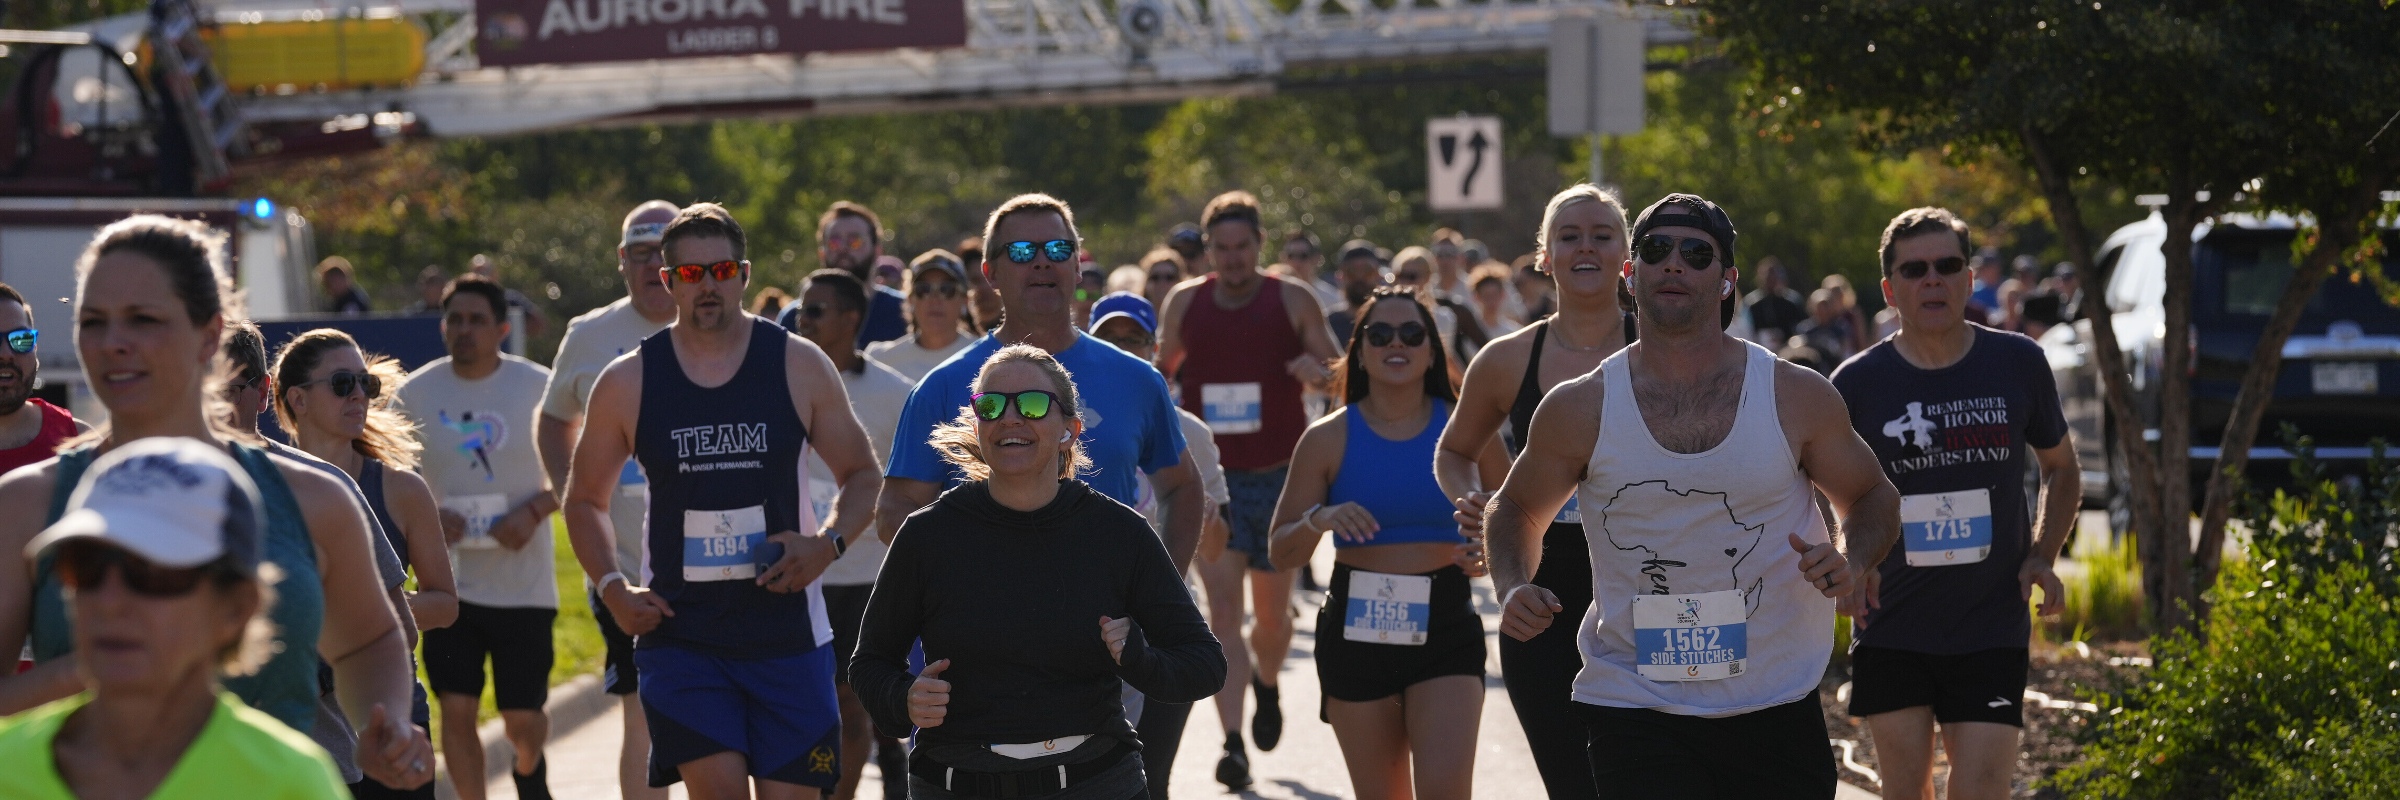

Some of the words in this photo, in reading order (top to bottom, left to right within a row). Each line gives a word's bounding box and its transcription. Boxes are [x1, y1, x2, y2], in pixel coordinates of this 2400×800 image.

[537, 0, 769, 40] AURORA
[788, 0, 908, 25] FIRE
[1927, 397, 2007, 416] REMEMBER
[1944, 409, 2009, 428] HONOR
[671, 423, 768, 458] TEAM
[692, 463, 715, 472] KAISER
[1891, 447, 2010, 474] UNDERSTAND
[1564, 510, 1580, 522] SID
[1925, 518, 1972, 541] 1715
[703, 535, 750, 557] 1694
[1641, 560, 1687, 595] ken
[1364, 600, 1409, 621] 1556
[1662, 626, 1721, 652] 1562
[1650, 651, 1677, 665] SIDE
[1680, 648, 1735, 665] STITCHES
